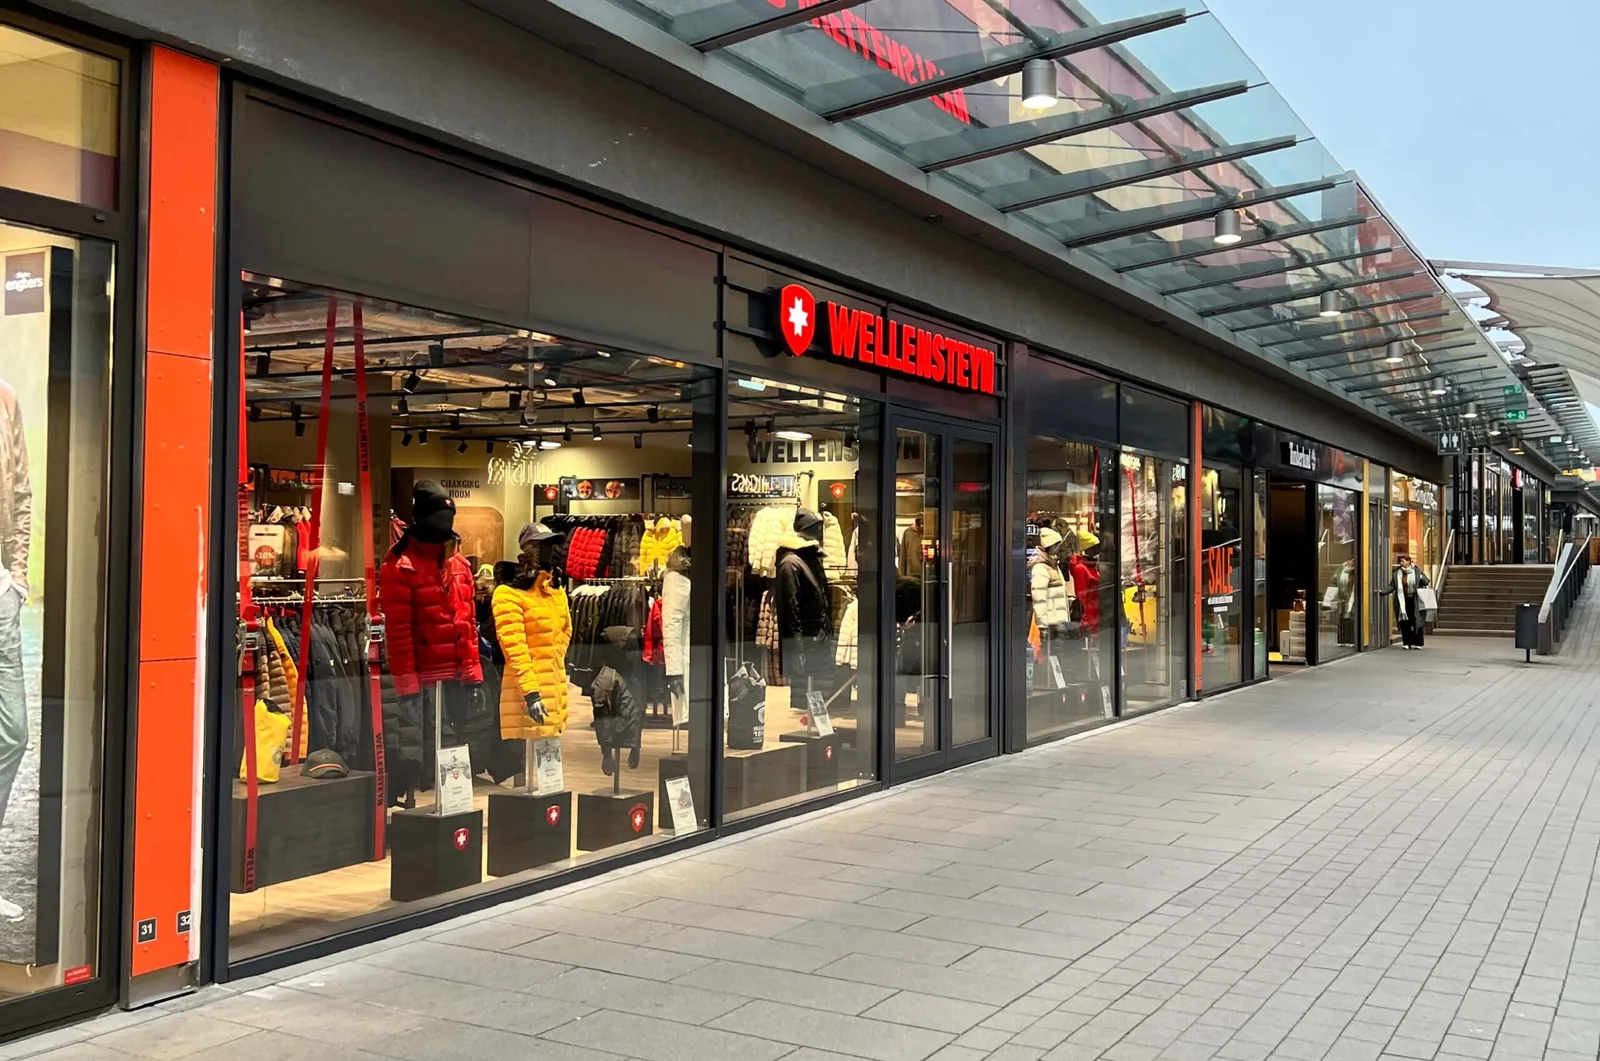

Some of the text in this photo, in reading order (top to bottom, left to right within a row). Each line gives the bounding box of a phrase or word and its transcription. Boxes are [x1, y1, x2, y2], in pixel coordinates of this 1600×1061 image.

[827, 301, 996, 394] WELLENSTEYN
[440, 479, 480, 489] CHANGING
[449, 489, 471, 499] ROOM
[255, 552, 276, 560] -10%
[1208, 546, 1233, 595] SALE
[180, 915, 191, 926] 32
[141, 923, 153, 936] 31
